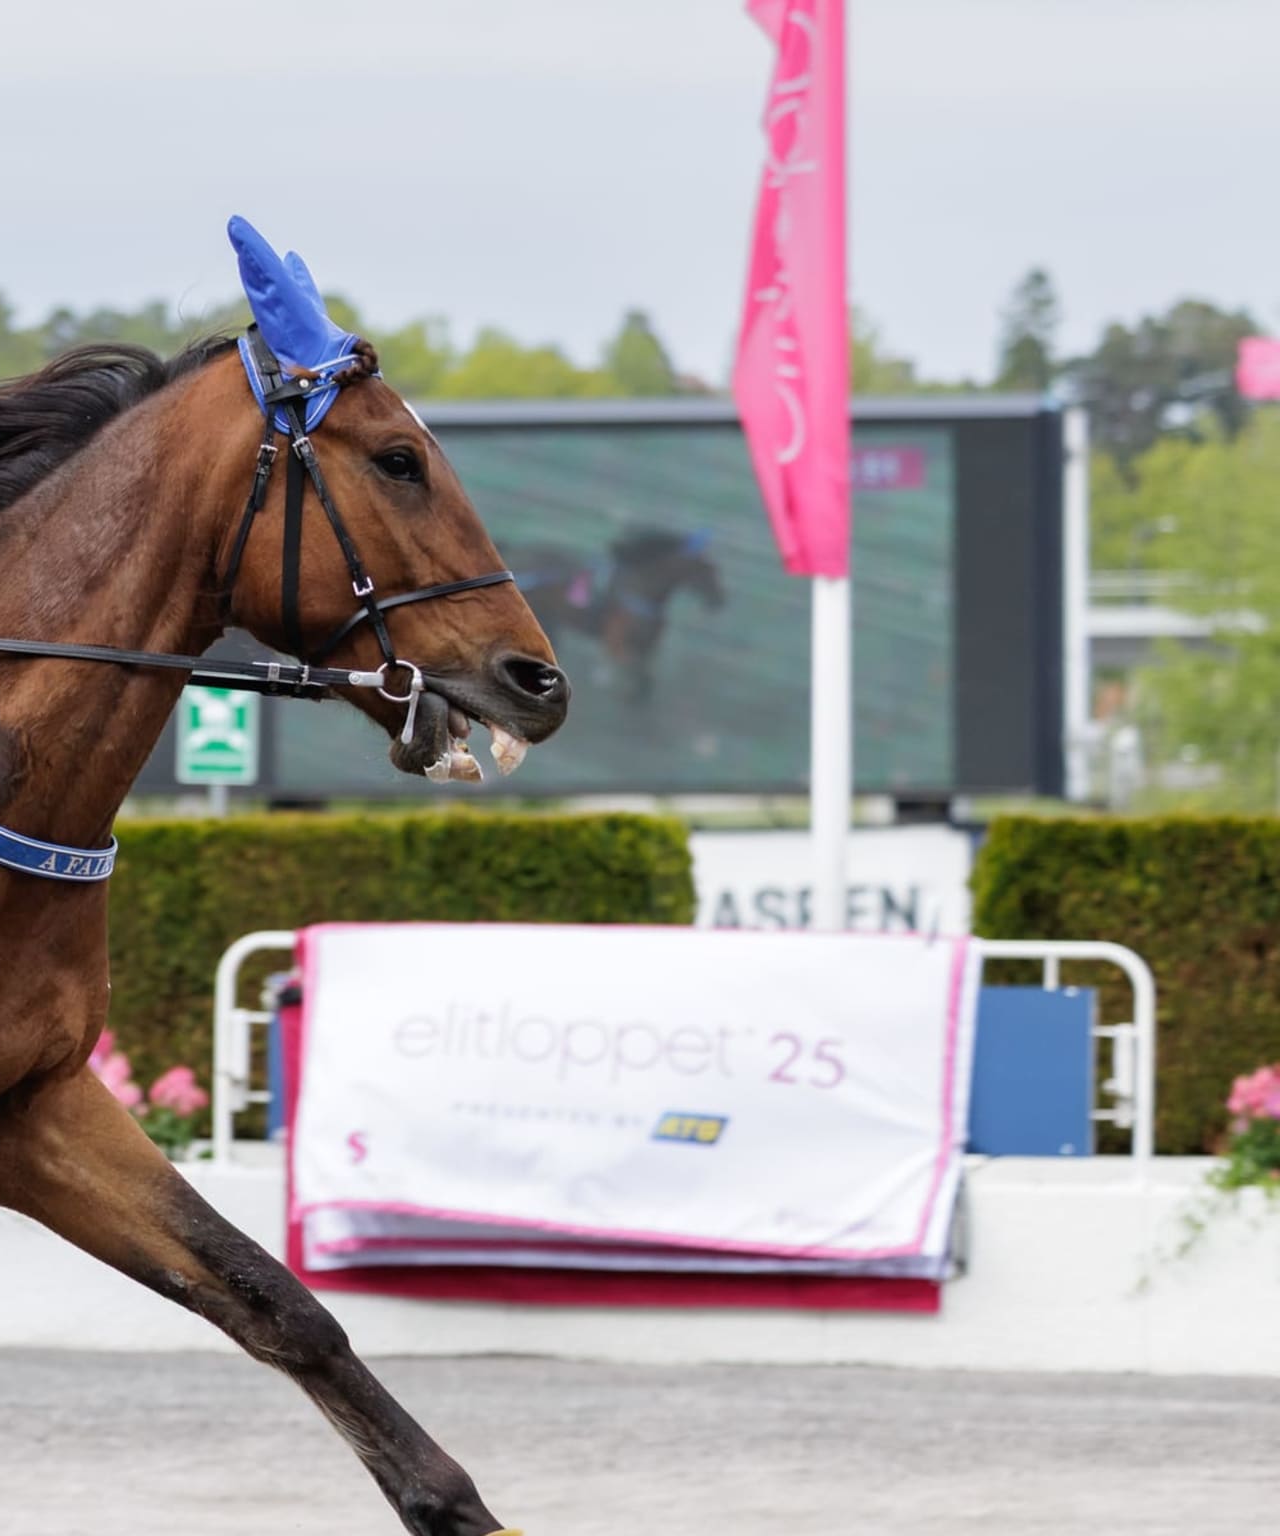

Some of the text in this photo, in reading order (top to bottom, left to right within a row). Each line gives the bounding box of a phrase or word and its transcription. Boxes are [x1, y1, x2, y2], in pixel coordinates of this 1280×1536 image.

[38, 852, 57, 872] A
[393, 999, 848, 1089] elitloppet 25
